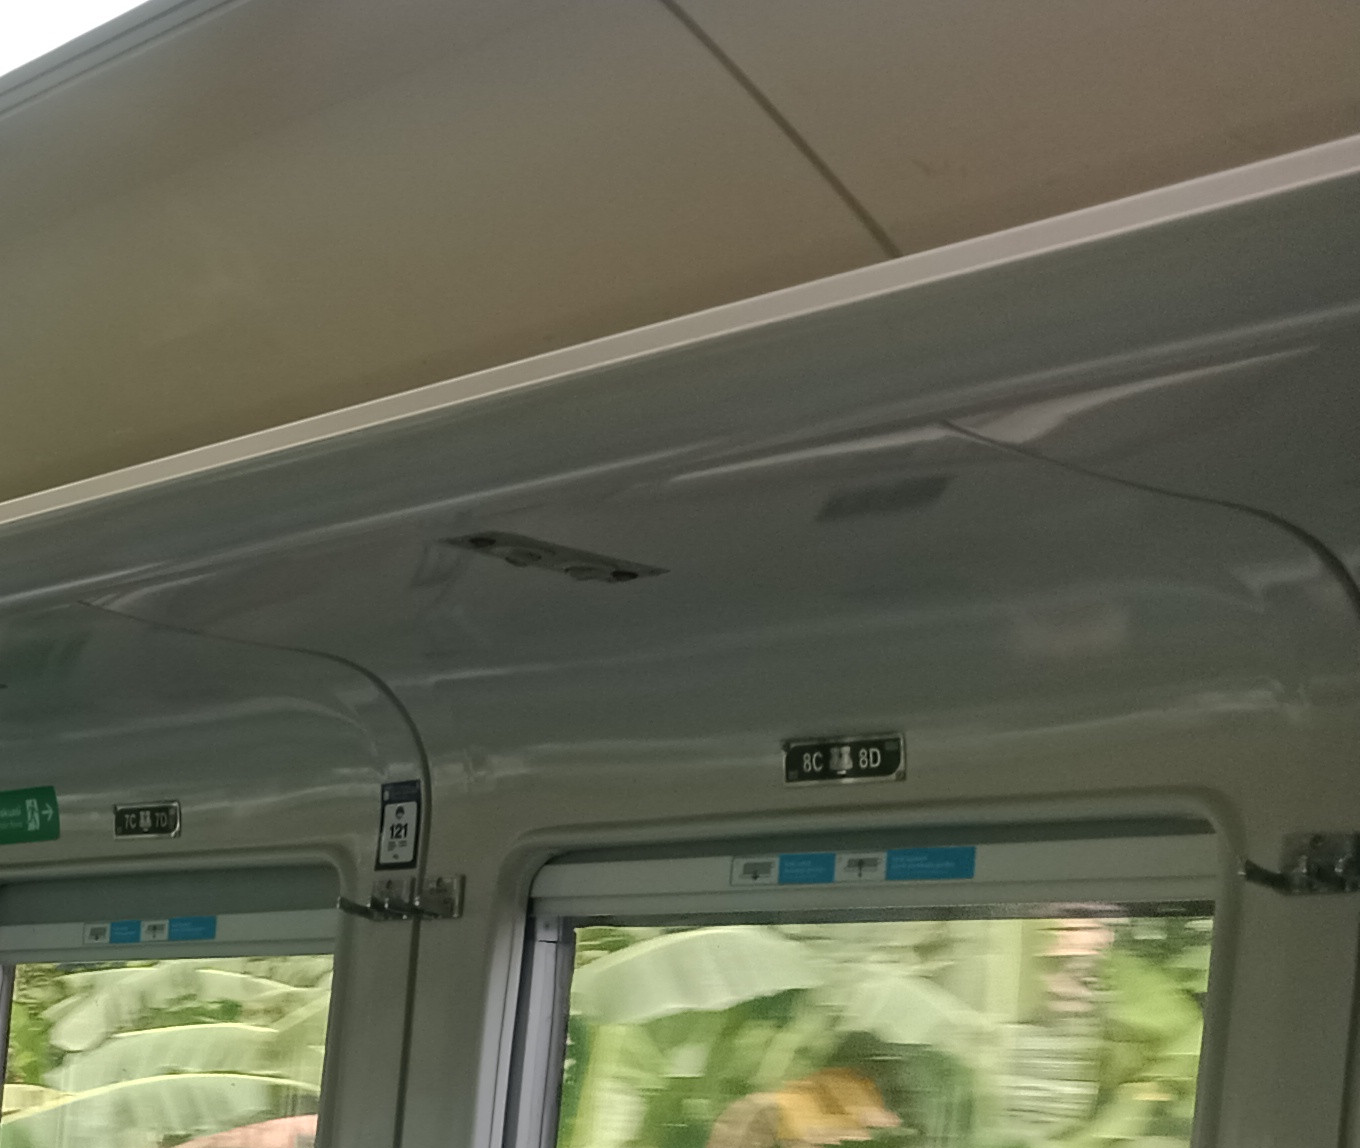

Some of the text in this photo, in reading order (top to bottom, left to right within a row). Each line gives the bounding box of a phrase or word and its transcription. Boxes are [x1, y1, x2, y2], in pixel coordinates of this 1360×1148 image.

[802, 747, 881, 773] 8C 8D
[124, 813, 137, 830] 7C
[389, 823, 409, 840] 121
